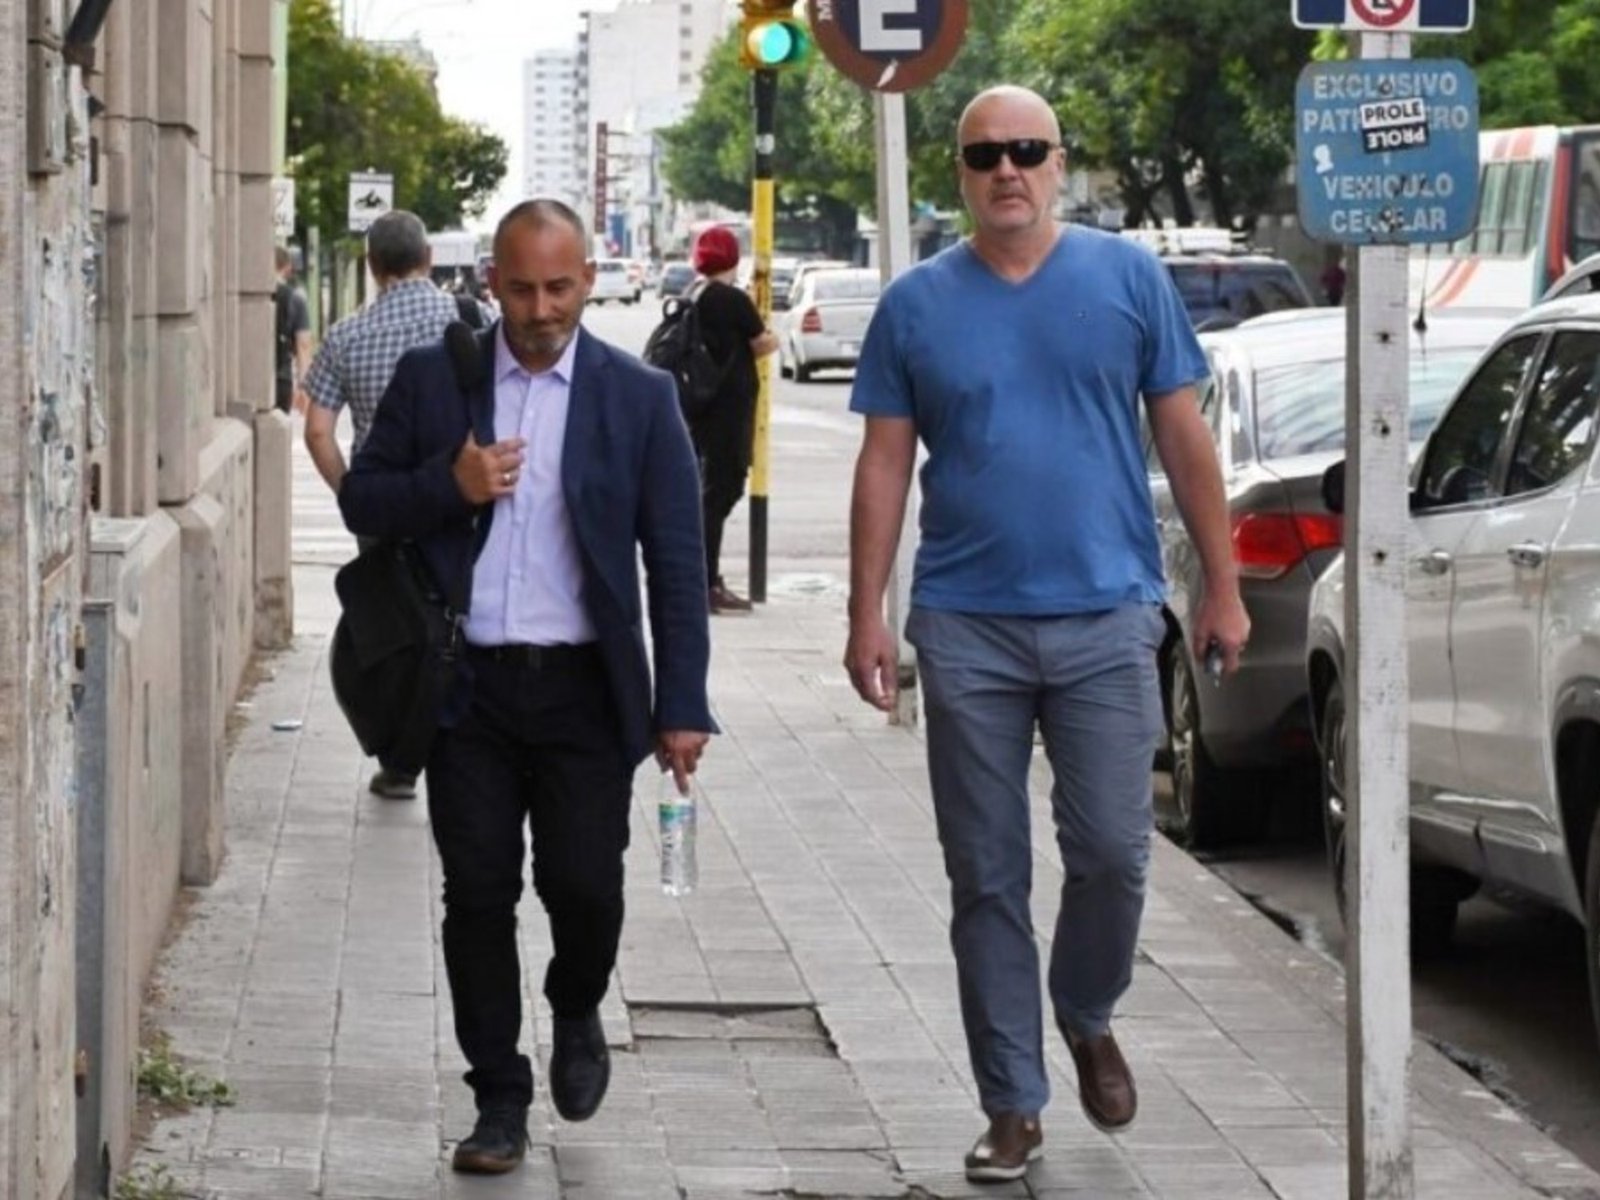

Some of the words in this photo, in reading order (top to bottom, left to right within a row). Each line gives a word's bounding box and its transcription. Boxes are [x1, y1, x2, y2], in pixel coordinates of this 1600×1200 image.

[1314, 72, 1458, 99] EXCLUSIVO
[1303, 105, 1469, 132] PATRO
[1364, 101, 1422, 122] PROLE
